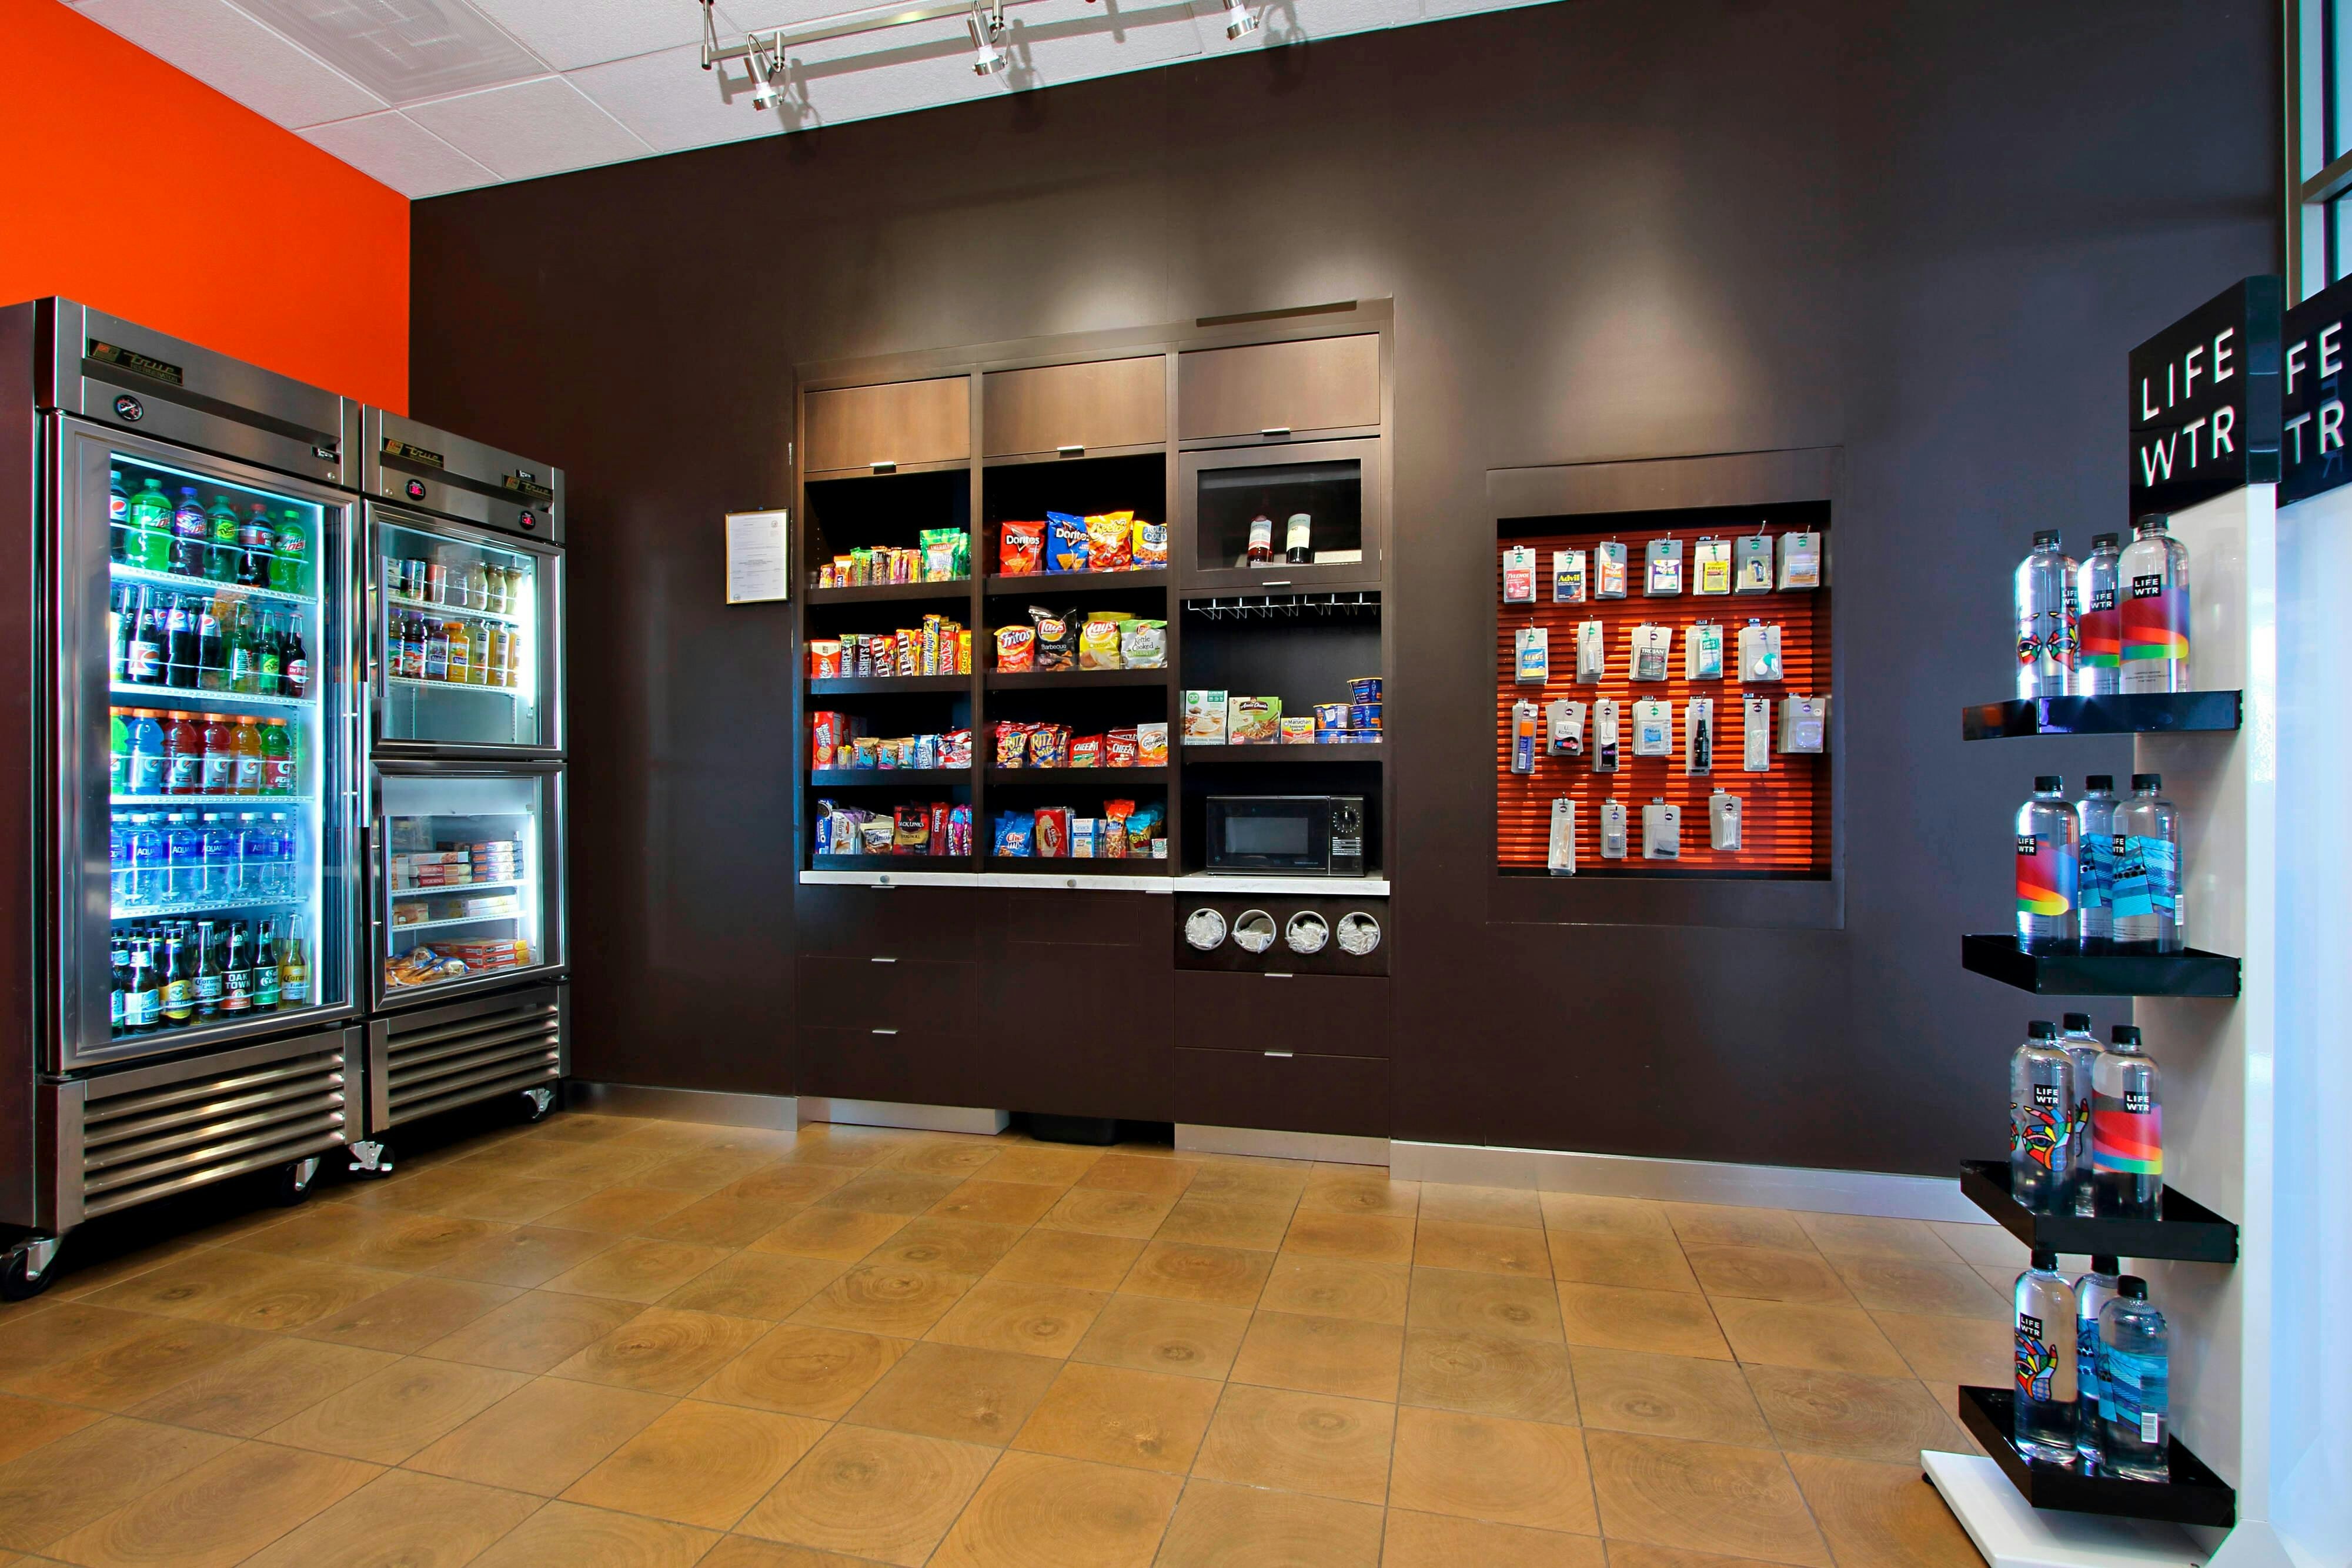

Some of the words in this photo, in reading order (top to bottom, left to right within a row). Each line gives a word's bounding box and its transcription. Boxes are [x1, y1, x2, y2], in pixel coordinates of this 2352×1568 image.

[2286, 321, 2343, 395] FE
[2141, 327, 2234, 422] LIFE
[2284, 399, 2345, 464] TR
[2140, 405, 2234, 487] WTR
[1056, 527, 1090, 541] Doritos
[1144, 532, 1167, 541] GOLD
[1006, 534, 1040, 545] Doritos
[1558, 573, 1581, 582] Advil
[2134, 578, 2159, 587] LIFE
[2134, 587, 2159, 595] WTR
[2091, 593, 2112, 601] LIFE
[1000, 630, 1030, 649] Fritos
[1135, 636, 1151, 645] Kettle
[1132, 643, 1154, 652] Cooked
[940, 640, 953, 676] TWIX
[1005, 733, 1025, 750] RITZ
[1031, 733, 1054, 747] RITZ
[837, 817, 845, 840] Milano
[1129, 833, 1148, 843] CORN
[229, 974, 248, 982] OAK
[226, 981, 250, 989] TOWN
[2036, 1088, 2058, 1096] LIFE
[2036, 1096, 2058, 1105] WTR
[2126, 1094, 2149, 1103] LIFE
[2126, 1102, 2150, 1112] WTR
[2020, 1316, 2040, 1329] LIFE
[2020, 1325, 2040, 1337] WTR
